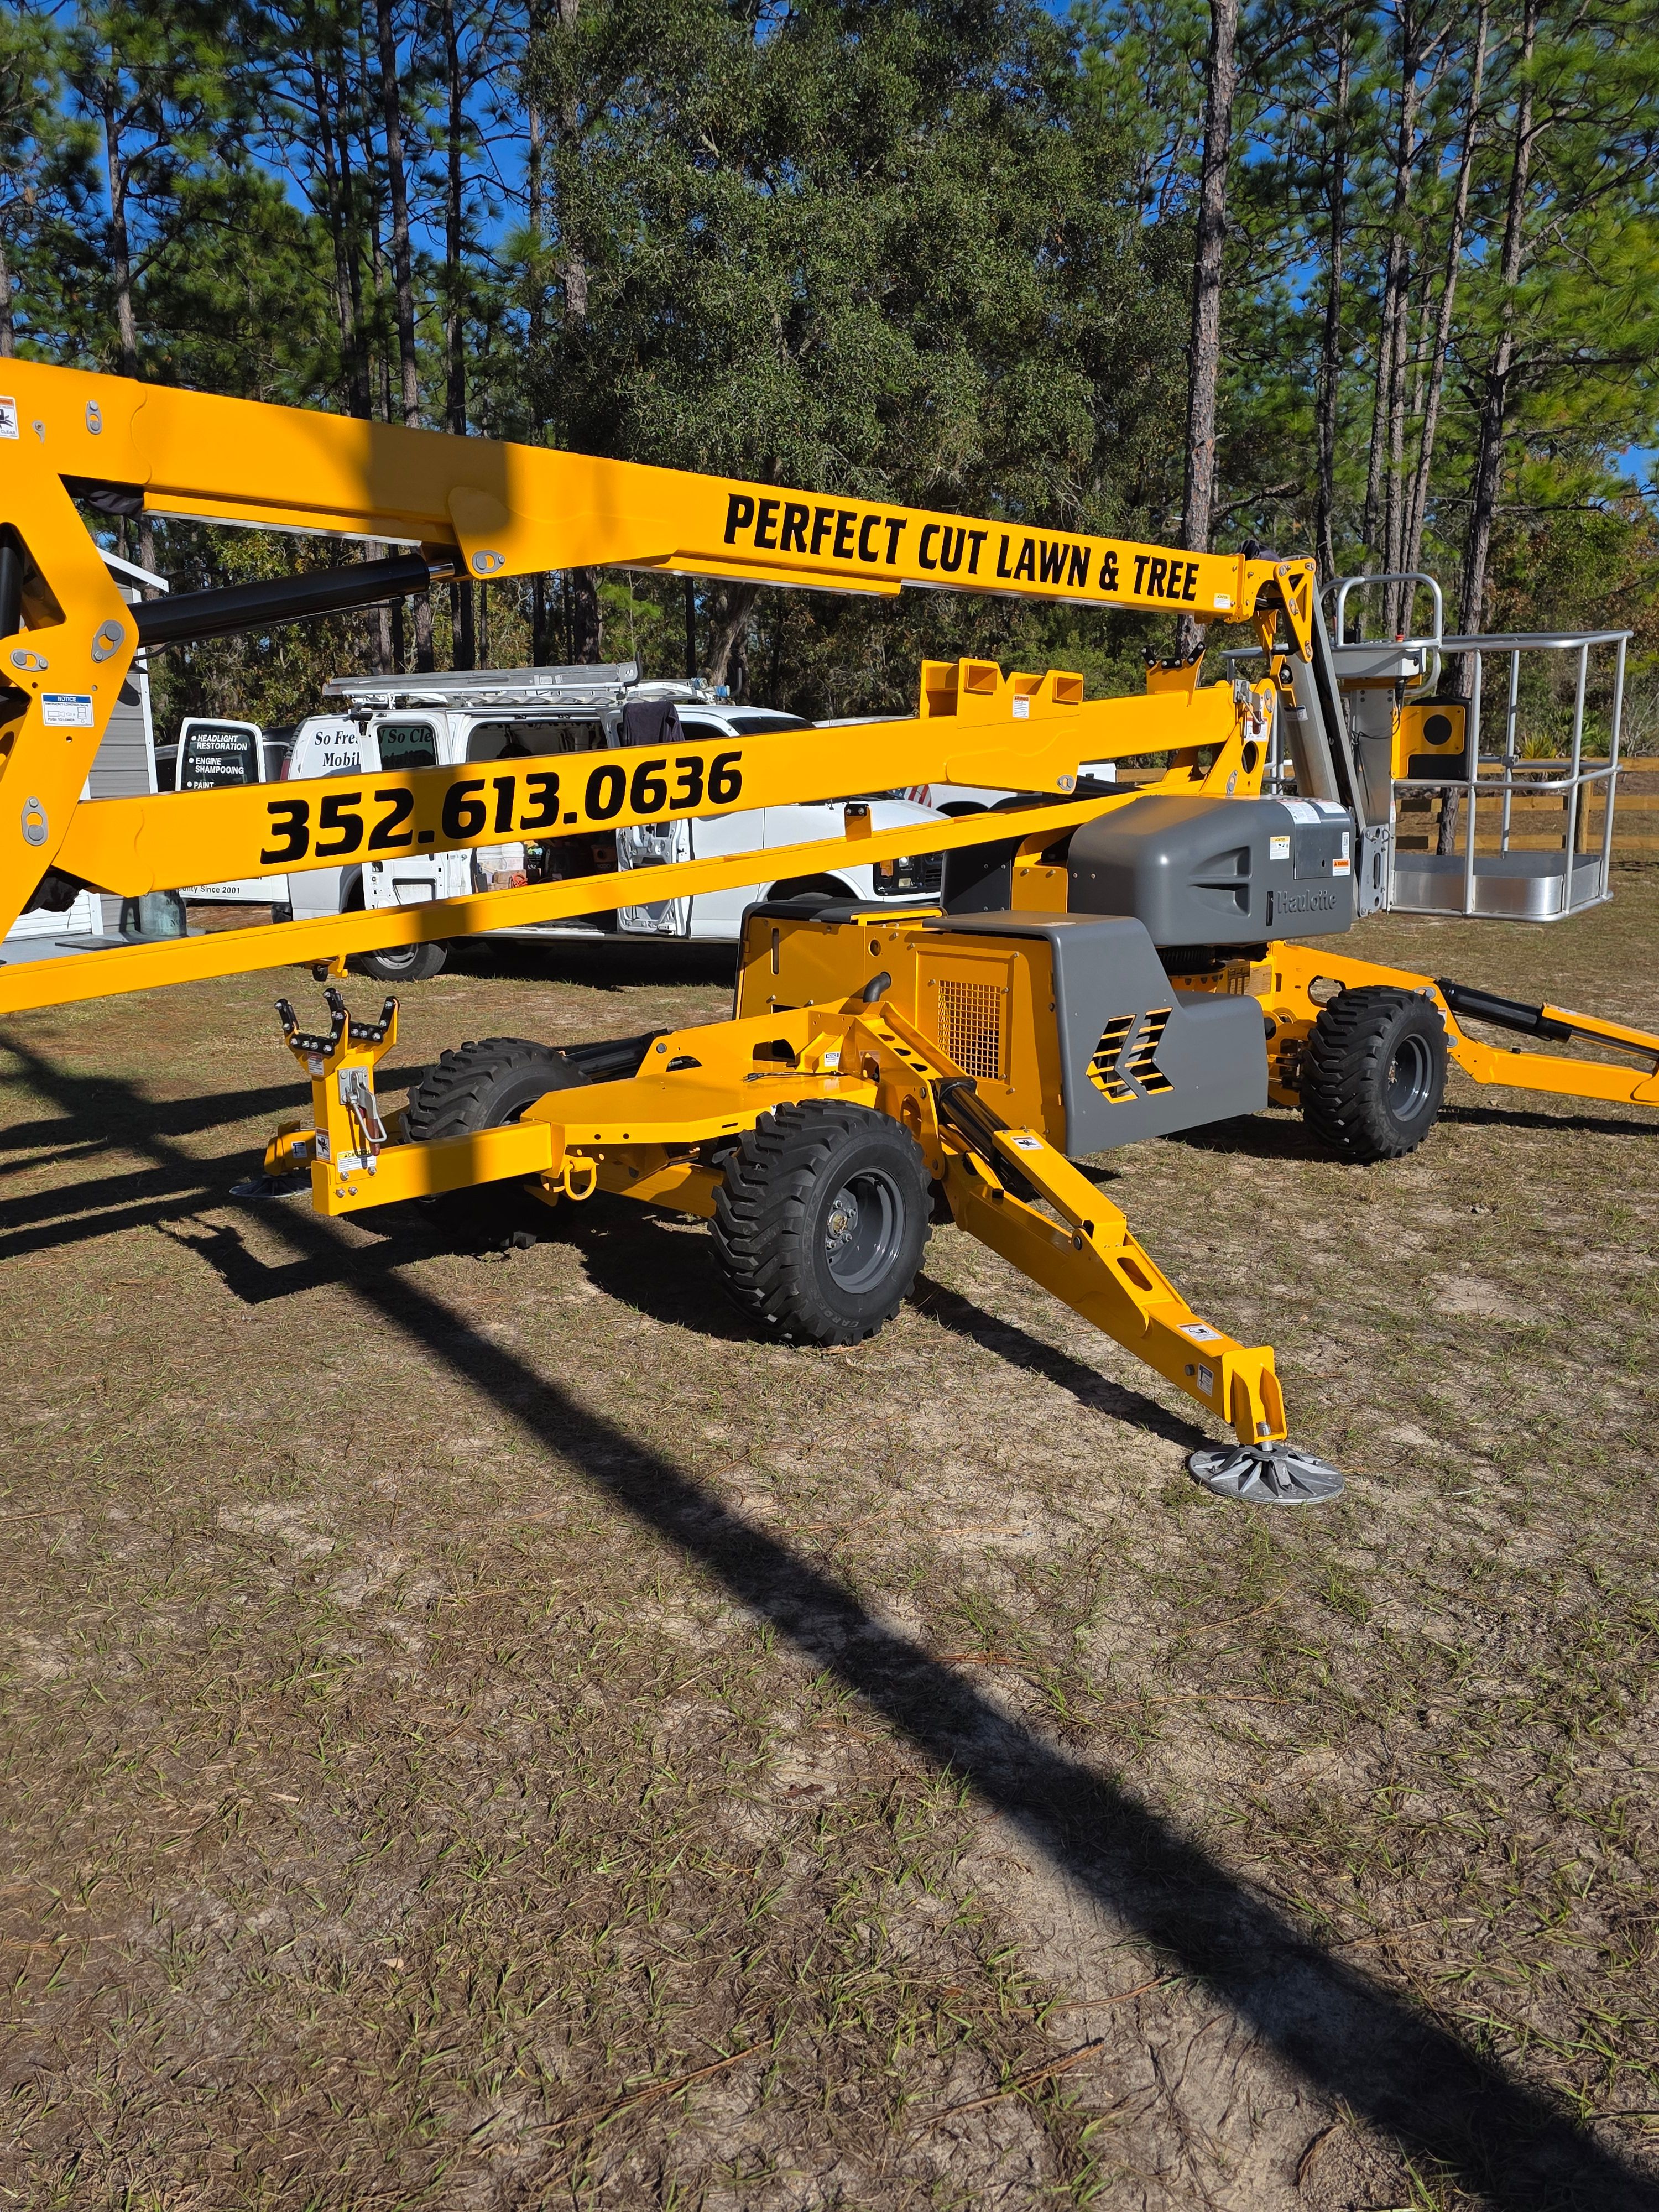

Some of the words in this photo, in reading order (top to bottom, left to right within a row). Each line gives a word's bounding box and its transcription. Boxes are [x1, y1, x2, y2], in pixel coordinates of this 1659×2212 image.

[723, 493, 907, 565] PERFECT
[919, 524, 988, 575] CUT
[996, 535, 1092, 587] LAWN
[1099, 550, 1119, 591] &
[1134, 554, 1200, 601] TREE
[197, 734, 239, 743] HEADLIGHT
[315, 731, 331, 745] So
[388, 729, 405, 743] So
[196, 742, 248, 751] RESTORATION
[196, 757, 222, 765] ENGINE
[195, 765, 244, 774] SHAMPOOING
[260, 751, 742, 865] 352.613.0636
[1277, 889, 1337, 914] Haulotte
